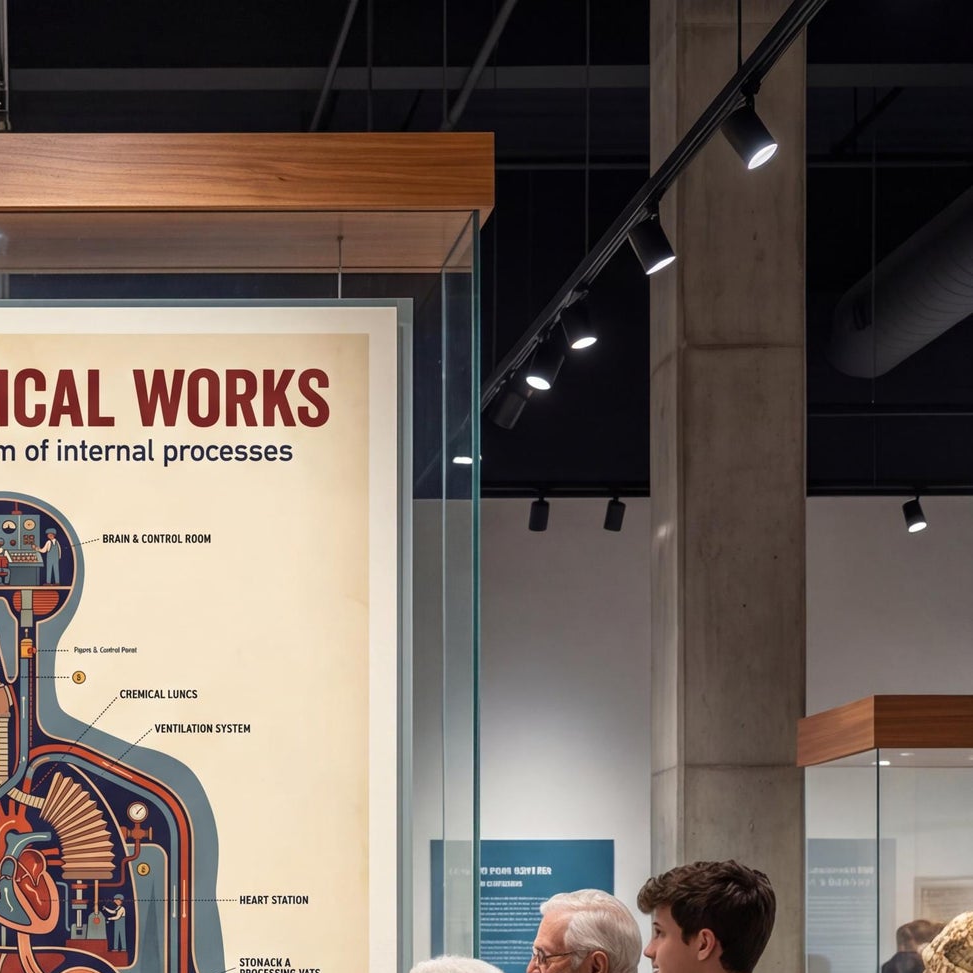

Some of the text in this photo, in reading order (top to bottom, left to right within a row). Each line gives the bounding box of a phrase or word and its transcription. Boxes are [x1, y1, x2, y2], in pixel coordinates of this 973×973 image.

[132, 368, 330, 428] WORKS
[24, 438, 50, 462] of
[57, 438, 155, 462] internal
[163, 444, 294, 468] processes
[102, 533, 212, 544] BRAIN & CONTROL ROOM
[119, 689, 166, 700] CREMICAL
[154, 723, 251, 734] VENTILATION SYSTEM
[239, 895, 309, 905] HEART STATION
[284, 957, 292, 967] A
